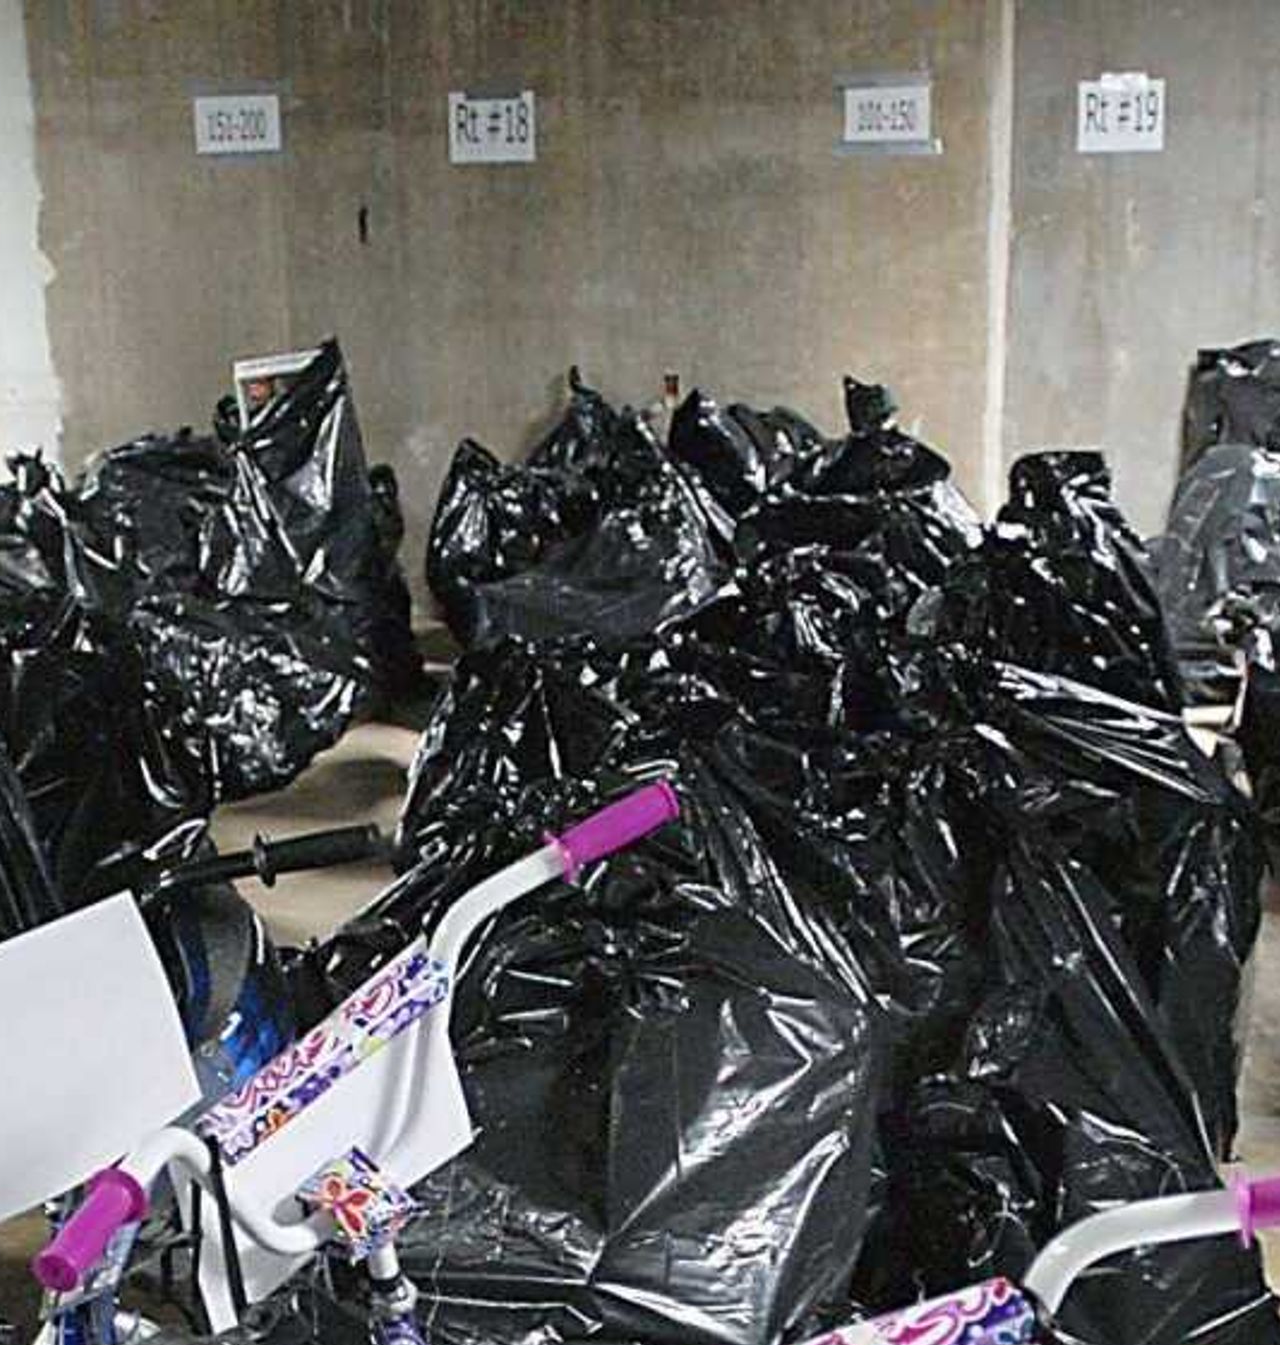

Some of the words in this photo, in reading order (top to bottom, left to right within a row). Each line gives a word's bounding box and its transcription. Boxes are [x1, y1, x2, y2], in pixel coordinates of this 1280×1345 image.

[207, 109, 267, 142] 151-200
[454, 103, 481, 143] Rt
[486, 102, 528, 143] #18
[857, 99, 916, 133] 101-150
[1084, 93, 1109, 133] Rt
[1117, 90, 1160, 131] #19
